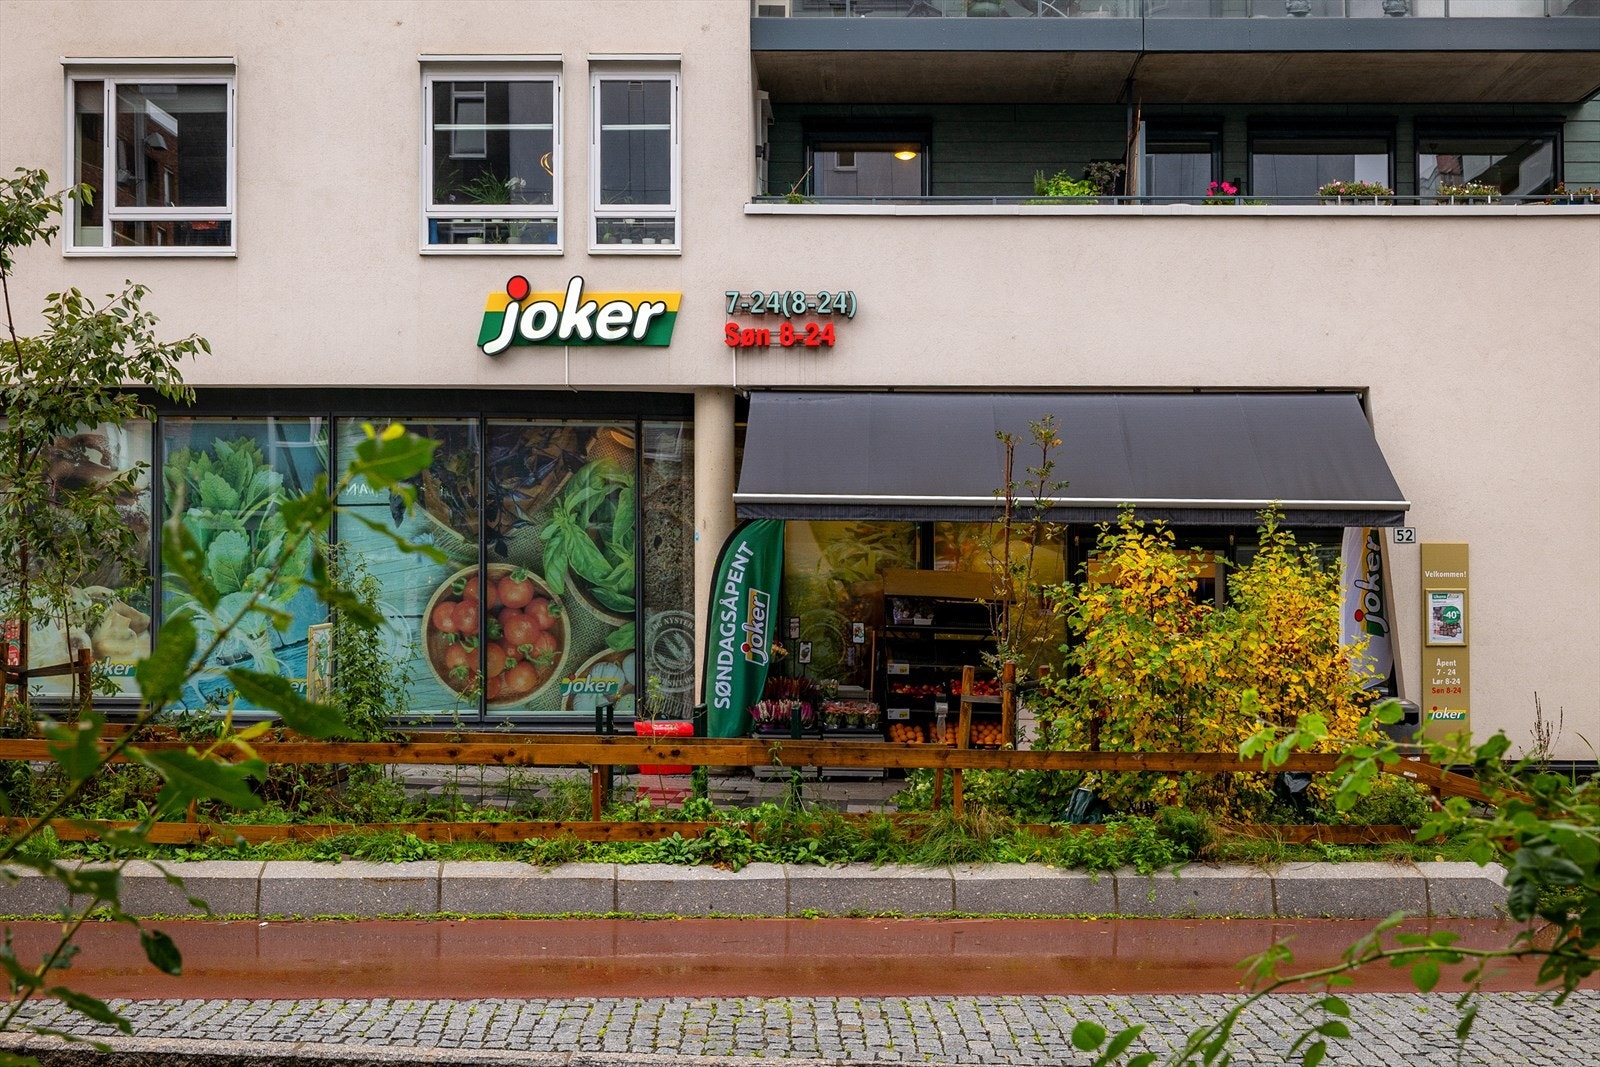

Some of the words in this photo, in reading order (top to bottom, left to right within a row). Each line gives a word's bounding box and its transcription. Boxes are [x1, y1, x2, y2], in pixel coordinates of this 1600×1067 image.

[482, 275, 667, 356] joker
[725, 290, 858, 319] 7-24(8-24)
[724, 322, 771, 348] Søn
[779, 321, 836, 348] 8-24
[1396, 529, 1413, 542] 52
[1354, 534, 1390, 634] joker
[1424, 570, 1467, 578] Velkommen!
[714, 540, 754, 710] SØNDAGSÅPENT
[741, 594, 768, 665] joker
[1436, 657, 1457, 667] Åpent
[562, 673, 616, 697] joker
[1445, 677, 1461, 685] 8-24
[1431, 706, 1464, 720] joker
